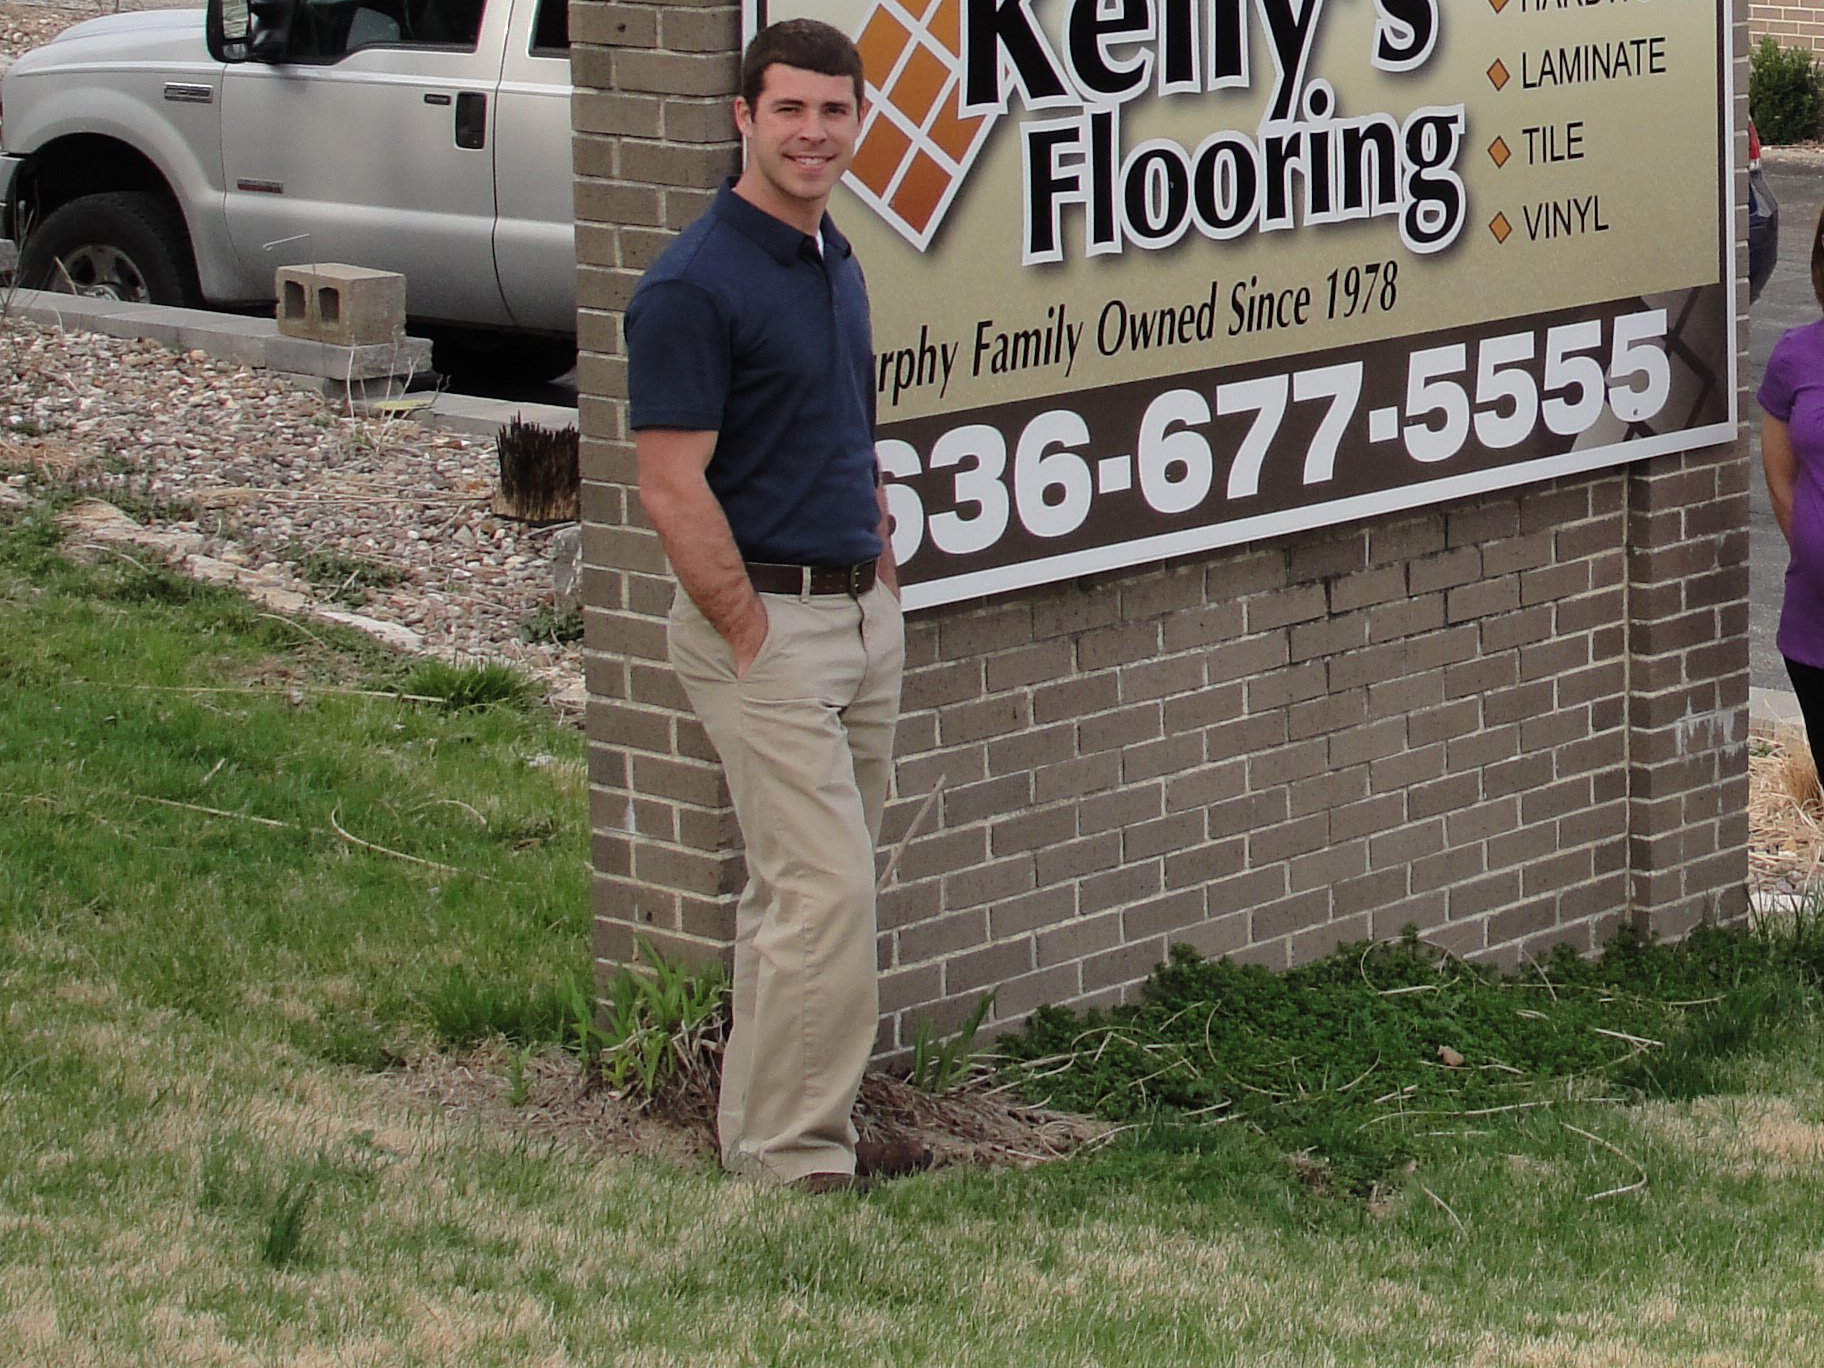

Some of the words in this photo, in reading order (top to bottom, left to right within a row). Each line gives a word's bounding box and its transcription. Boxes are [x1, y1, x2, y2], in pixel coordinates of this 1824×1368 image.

[1520, 36, 1667, 90] LAMINATE
[1022, 82, 1466, 253] Flooring
[1521, 120, 1585, 166] TILE
[1521, 194, 1610, 242] VINYL
[872, 324, 959, 406] rphy
[971, 303, 1084, 377] Family
[1096, 280, 1219, 357] Owned
[1228, 274, 1310, 337] Since
[1325, 259, 1400, 322] 1978
